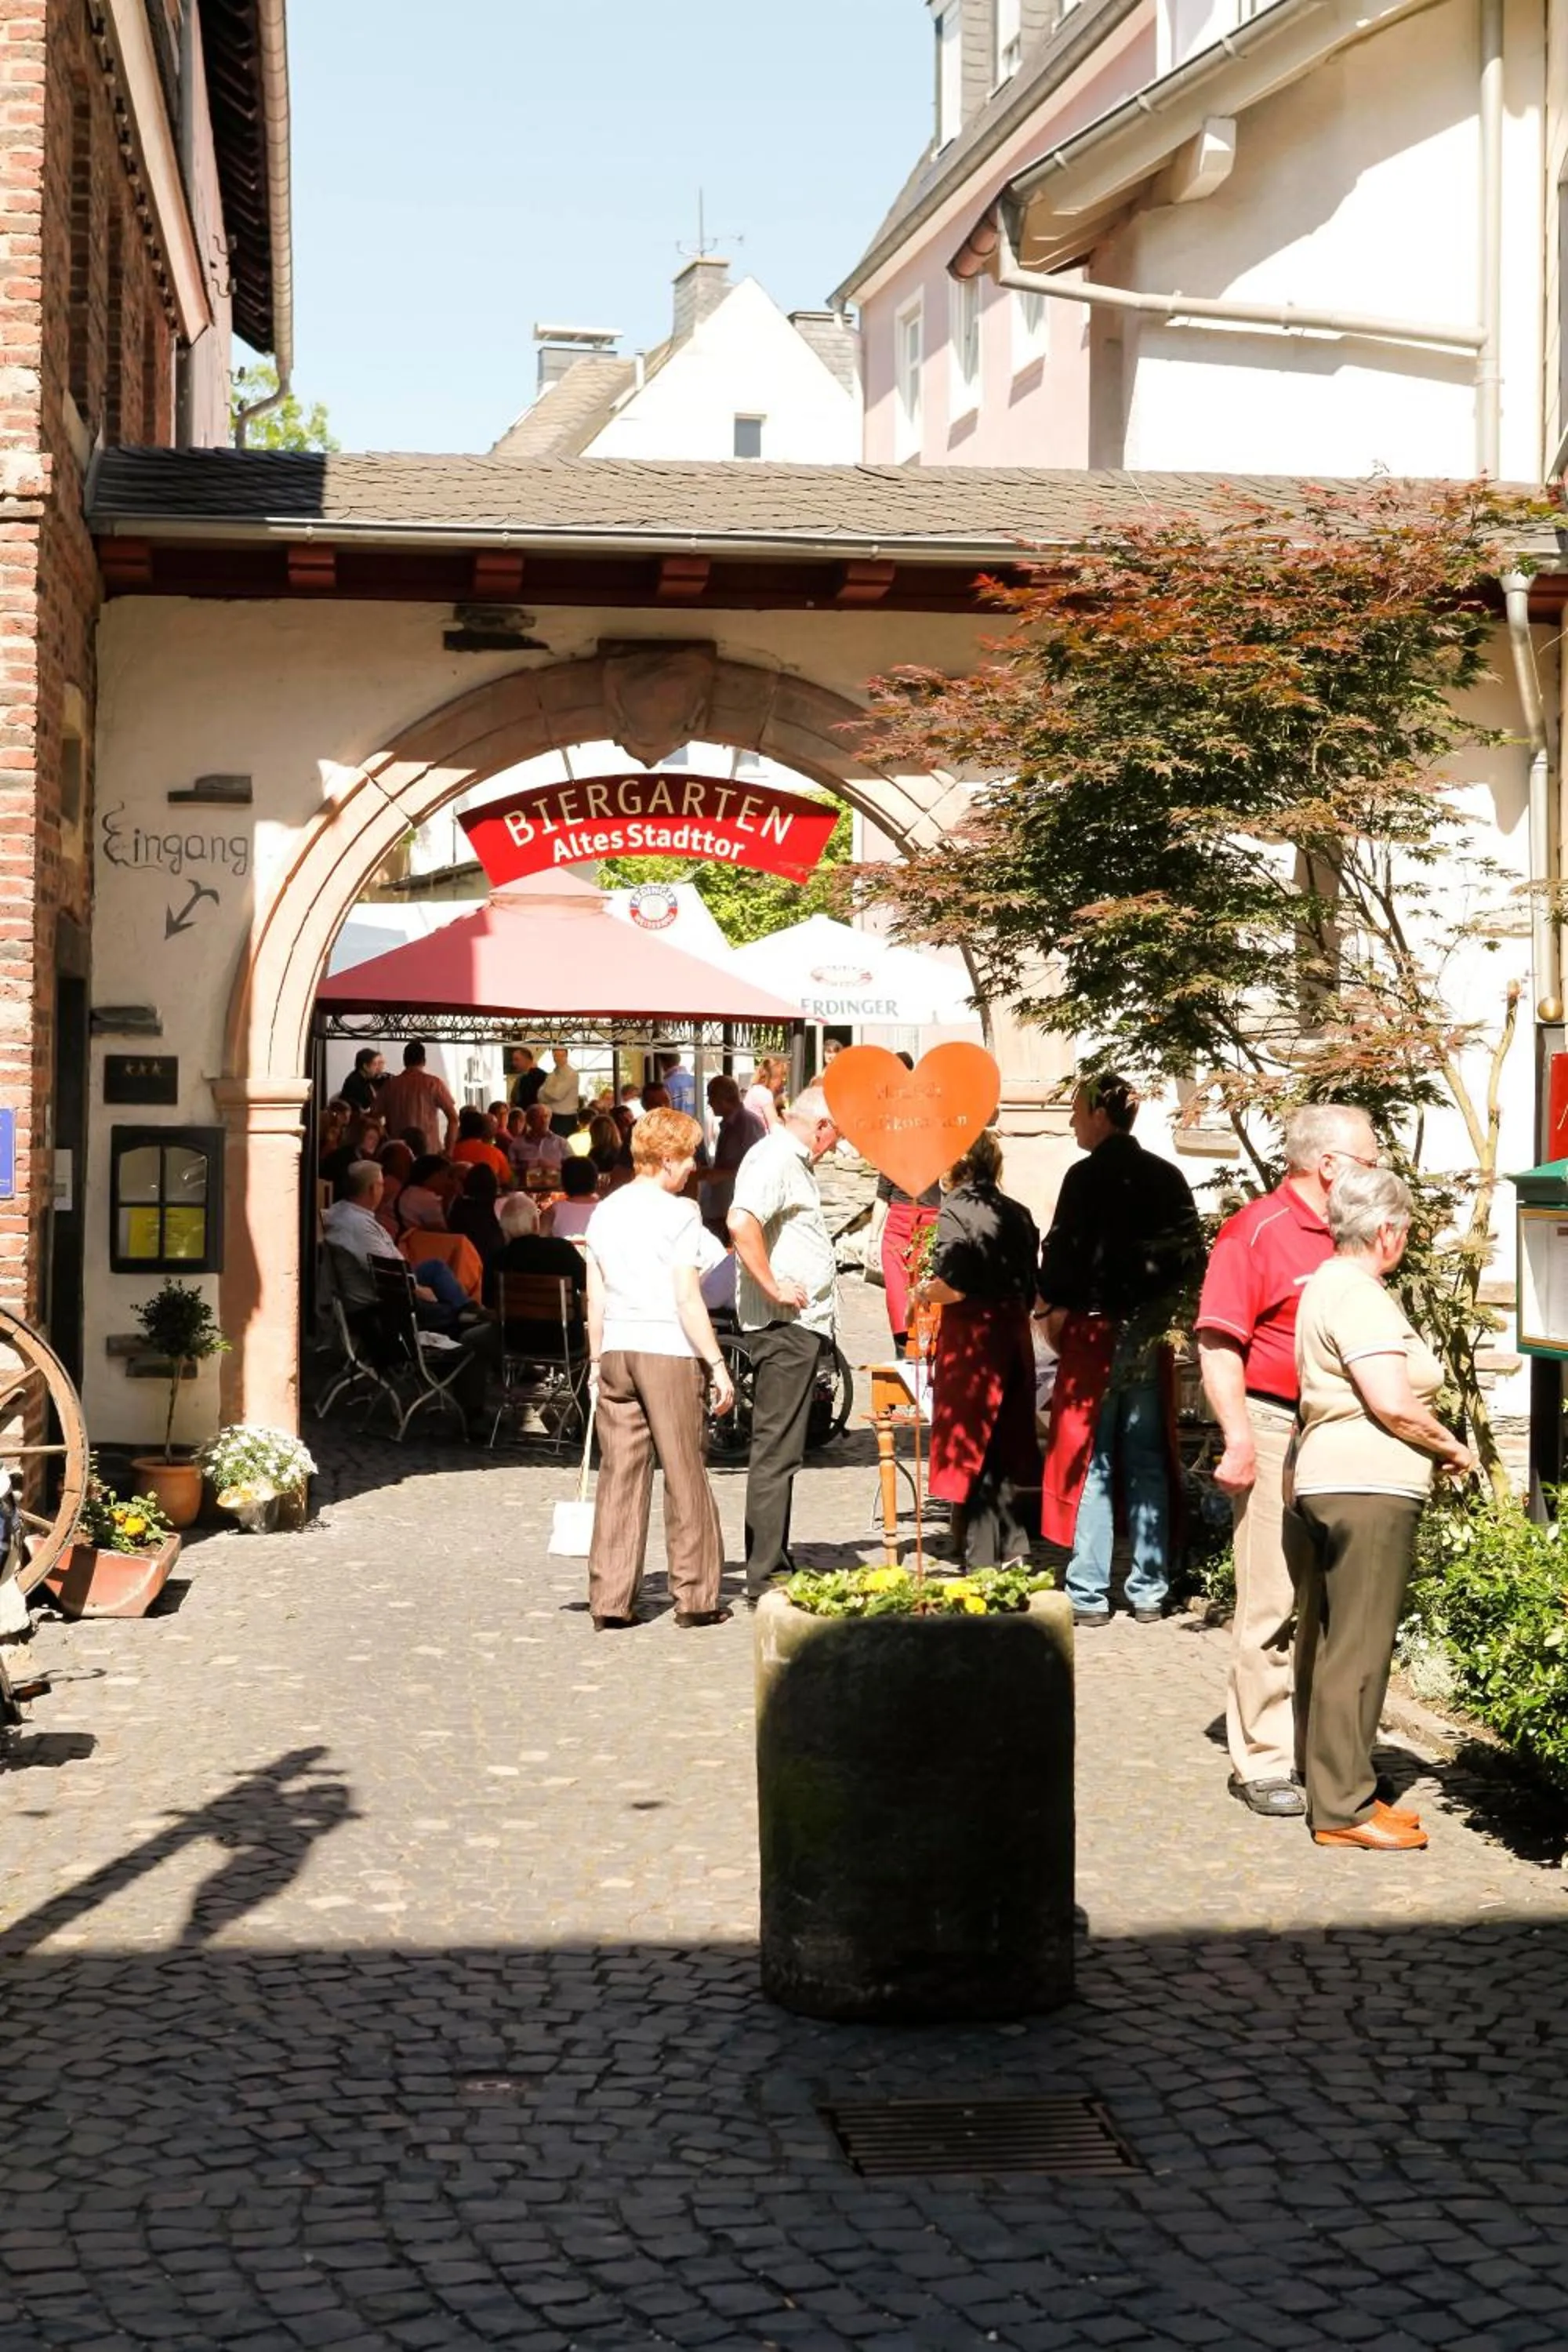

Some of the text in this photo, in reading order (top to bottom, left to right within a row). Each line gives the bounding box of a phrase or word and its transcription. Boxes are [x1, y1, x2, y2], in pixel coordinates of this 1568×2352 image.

[101, 800, 249, 876] Eingang
[503, 779, 795, 848] BIERGARTEN
[552, 822, 745, 862] Altes Stadttor
[800, 997, 899, 1018] ERDINGER
